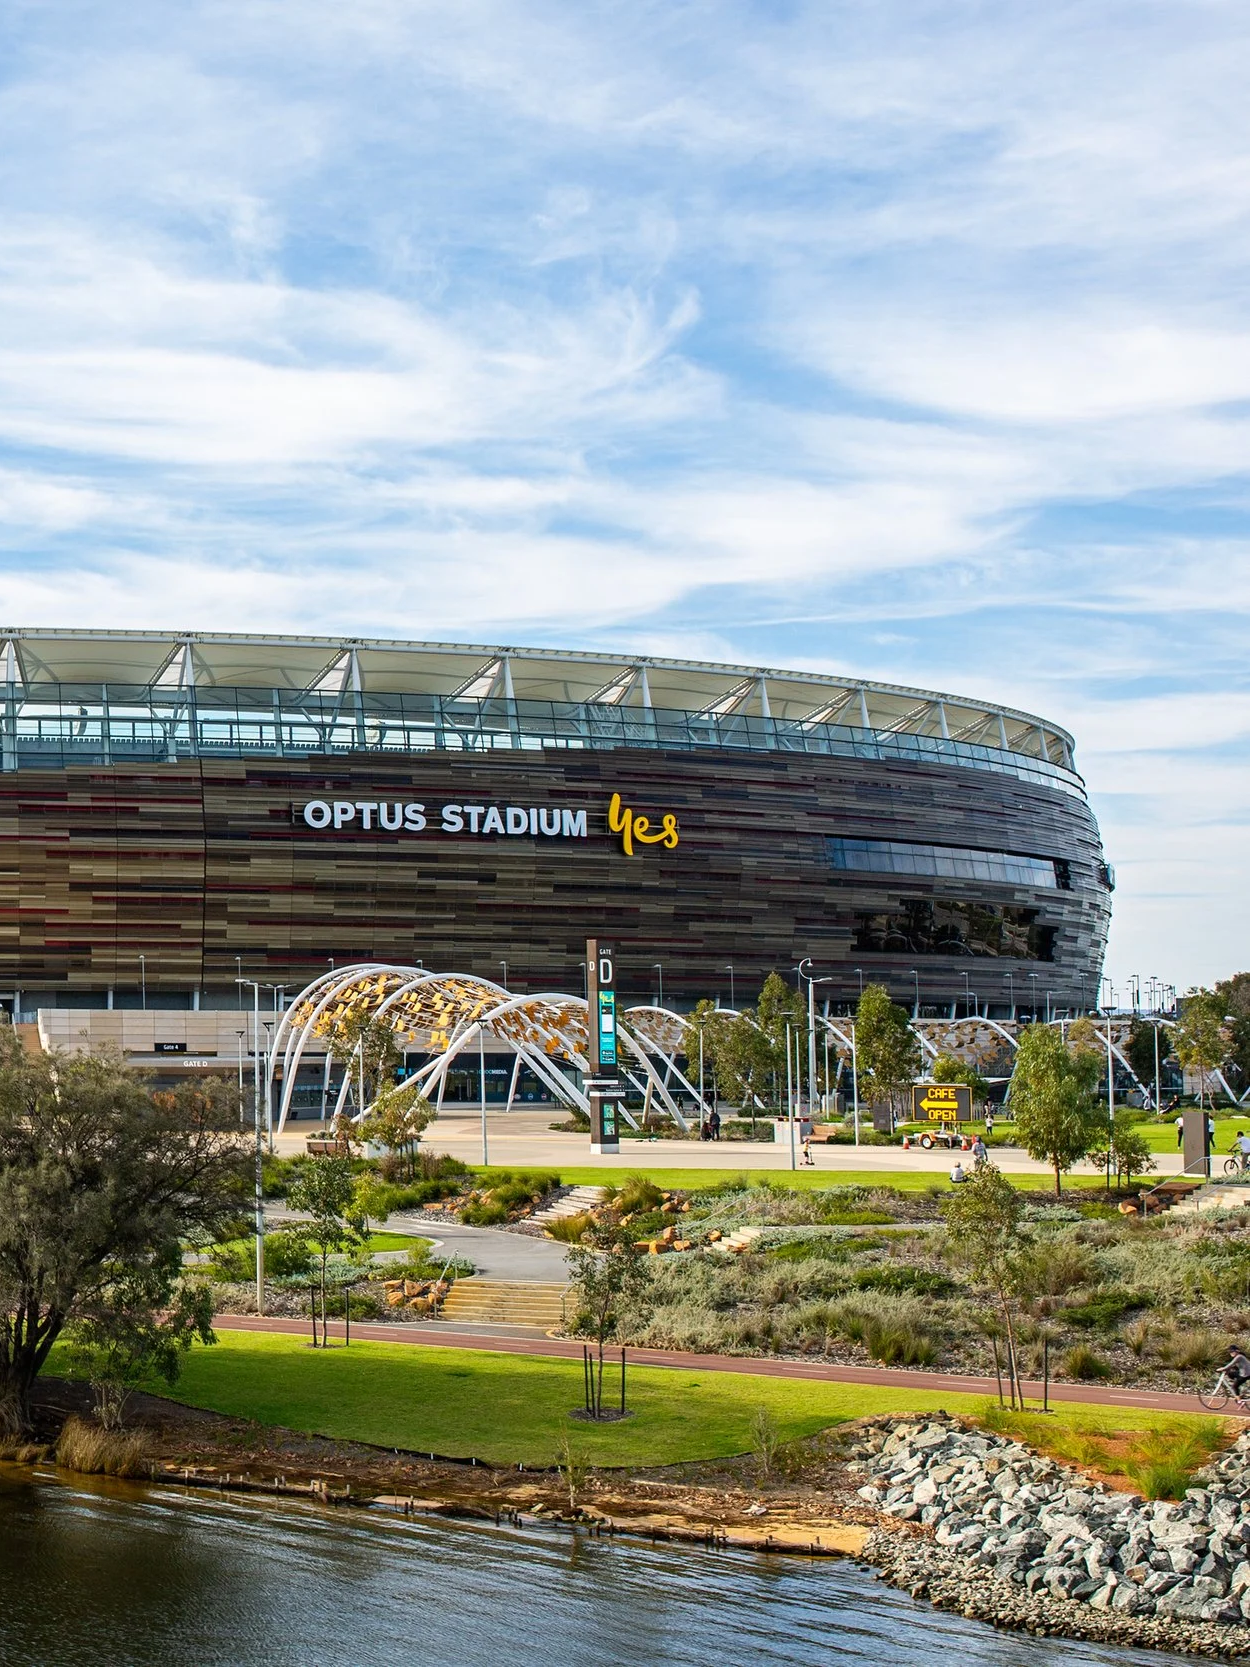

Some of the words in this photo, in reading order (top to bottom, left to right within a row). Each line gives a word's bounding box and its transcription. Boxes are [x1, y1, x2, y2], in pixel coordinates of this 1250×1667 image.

[303, 800, 427, 832] OPTUS
[441, 804, 588, 837] STADIUM
[599, 948, 612, 956] GATE
[589, 961, 595, 972] D
[599, 958, 613, 984] D
[927, 1088, 956, 1099] CAFE
[928, 1110, 957, 1120] OPEN
